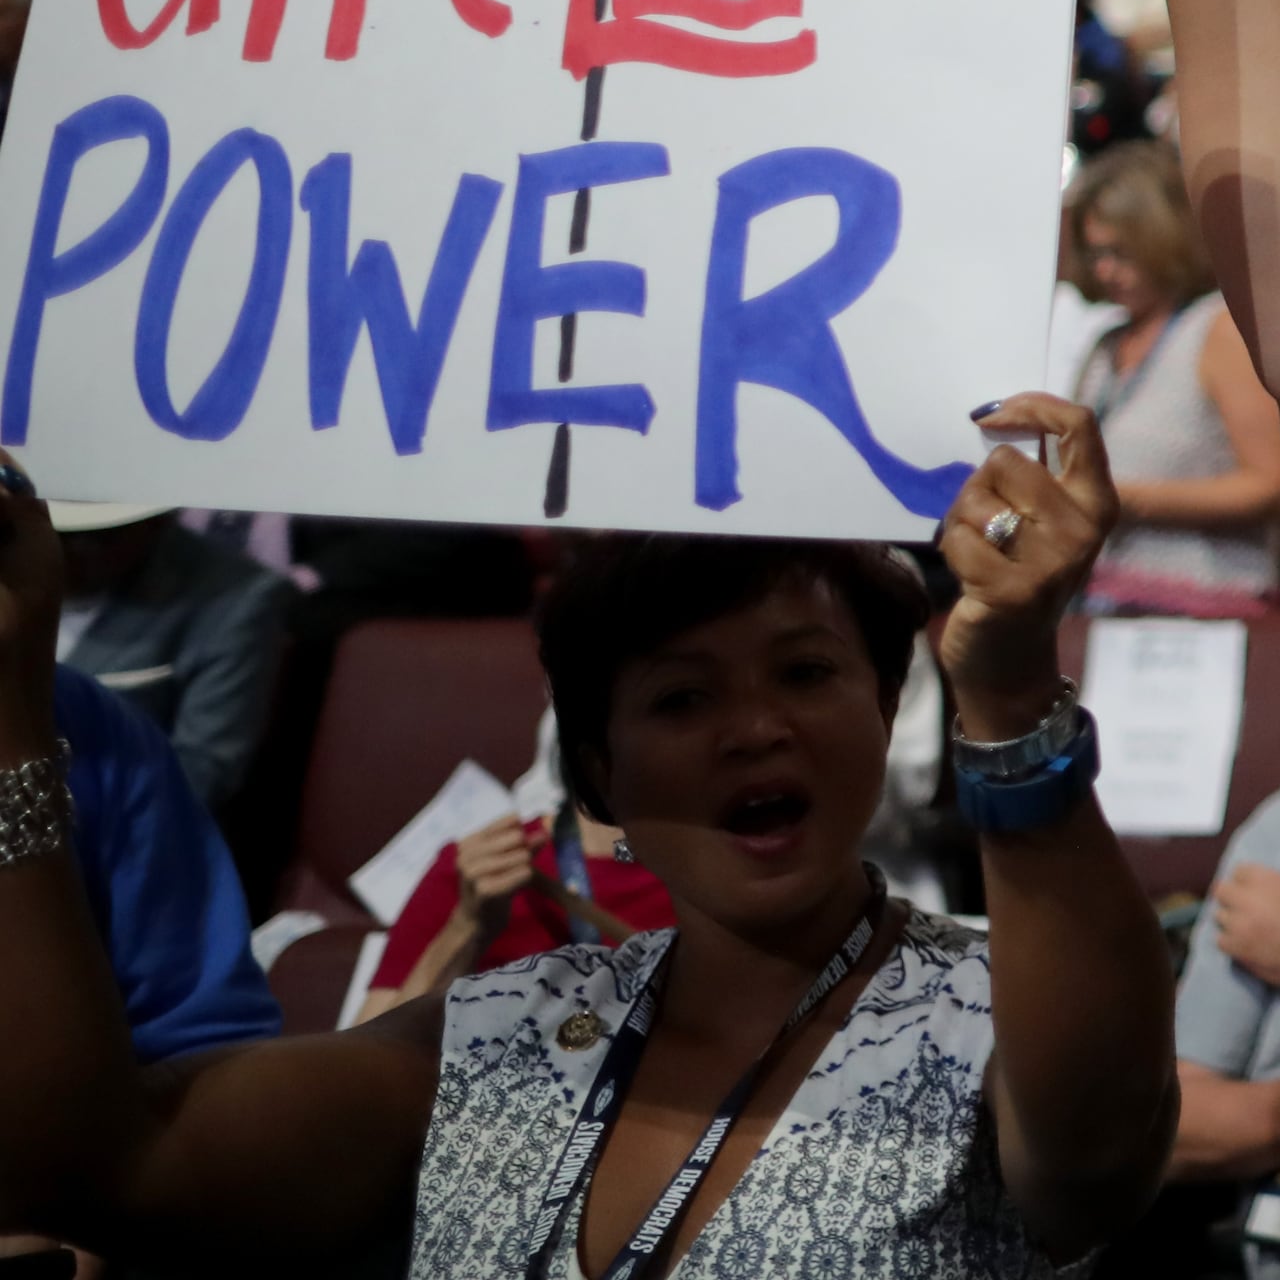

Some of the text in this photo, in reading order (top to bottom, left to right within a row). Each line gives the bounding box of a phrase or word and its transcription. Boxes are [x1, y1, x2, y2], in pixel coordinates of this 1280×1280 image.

[1, 95, 976, 520] POWER
[528, 1120, 605, 1257] HOUSE DEMOCRATS
[629, 1116, 731, 1254] HOUSE DEMOCRATS
